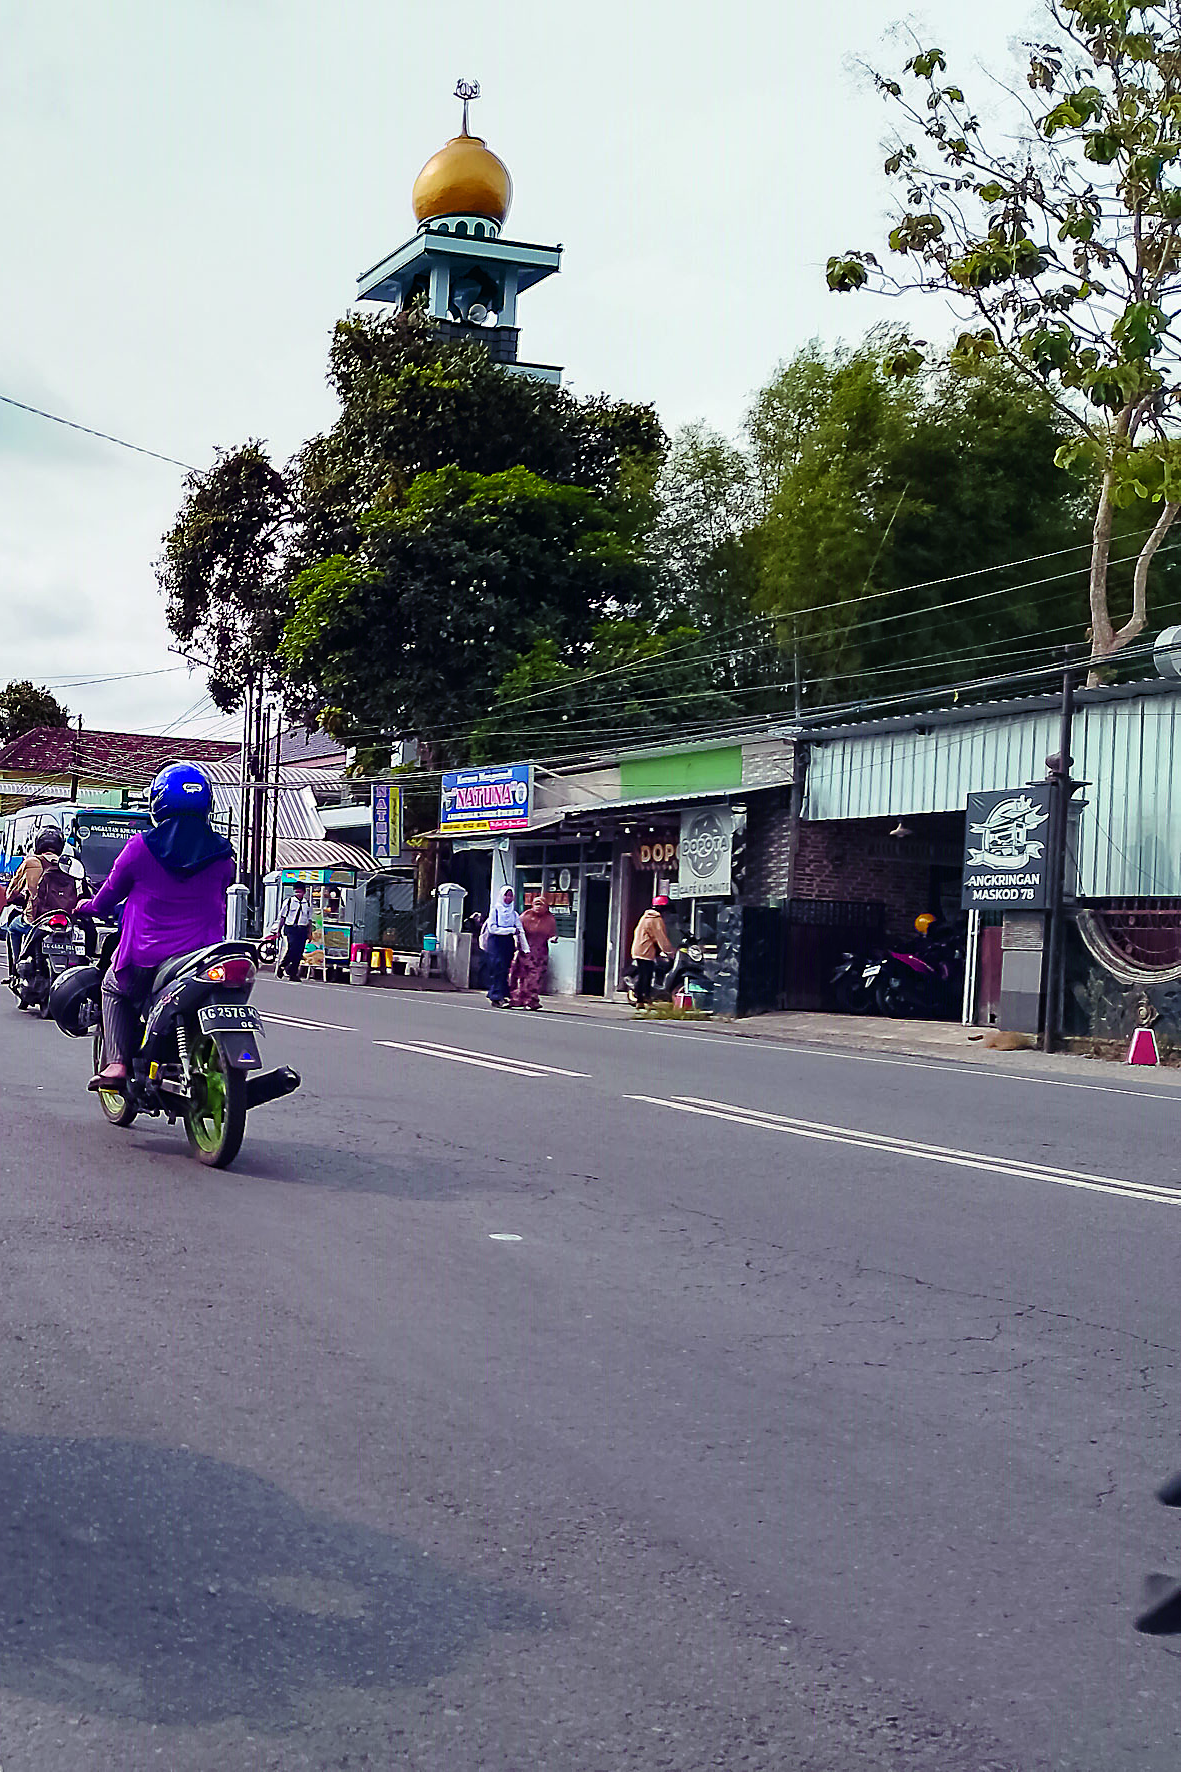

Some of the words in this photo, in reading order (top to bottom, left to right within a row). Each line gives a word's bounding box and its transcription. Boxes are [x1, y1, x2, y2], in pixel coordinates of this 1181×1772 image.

[682, 834, 729, 856] DOPOTA
[964, 873, 1041, 886] ANGKRINGAN
[972, 889, 1018, 900] MASKOD
[1021, 888, 1035, 900] 78
[201, 1009, 216, 1021] AG
[217, 1007, 246, 1018] 2576
